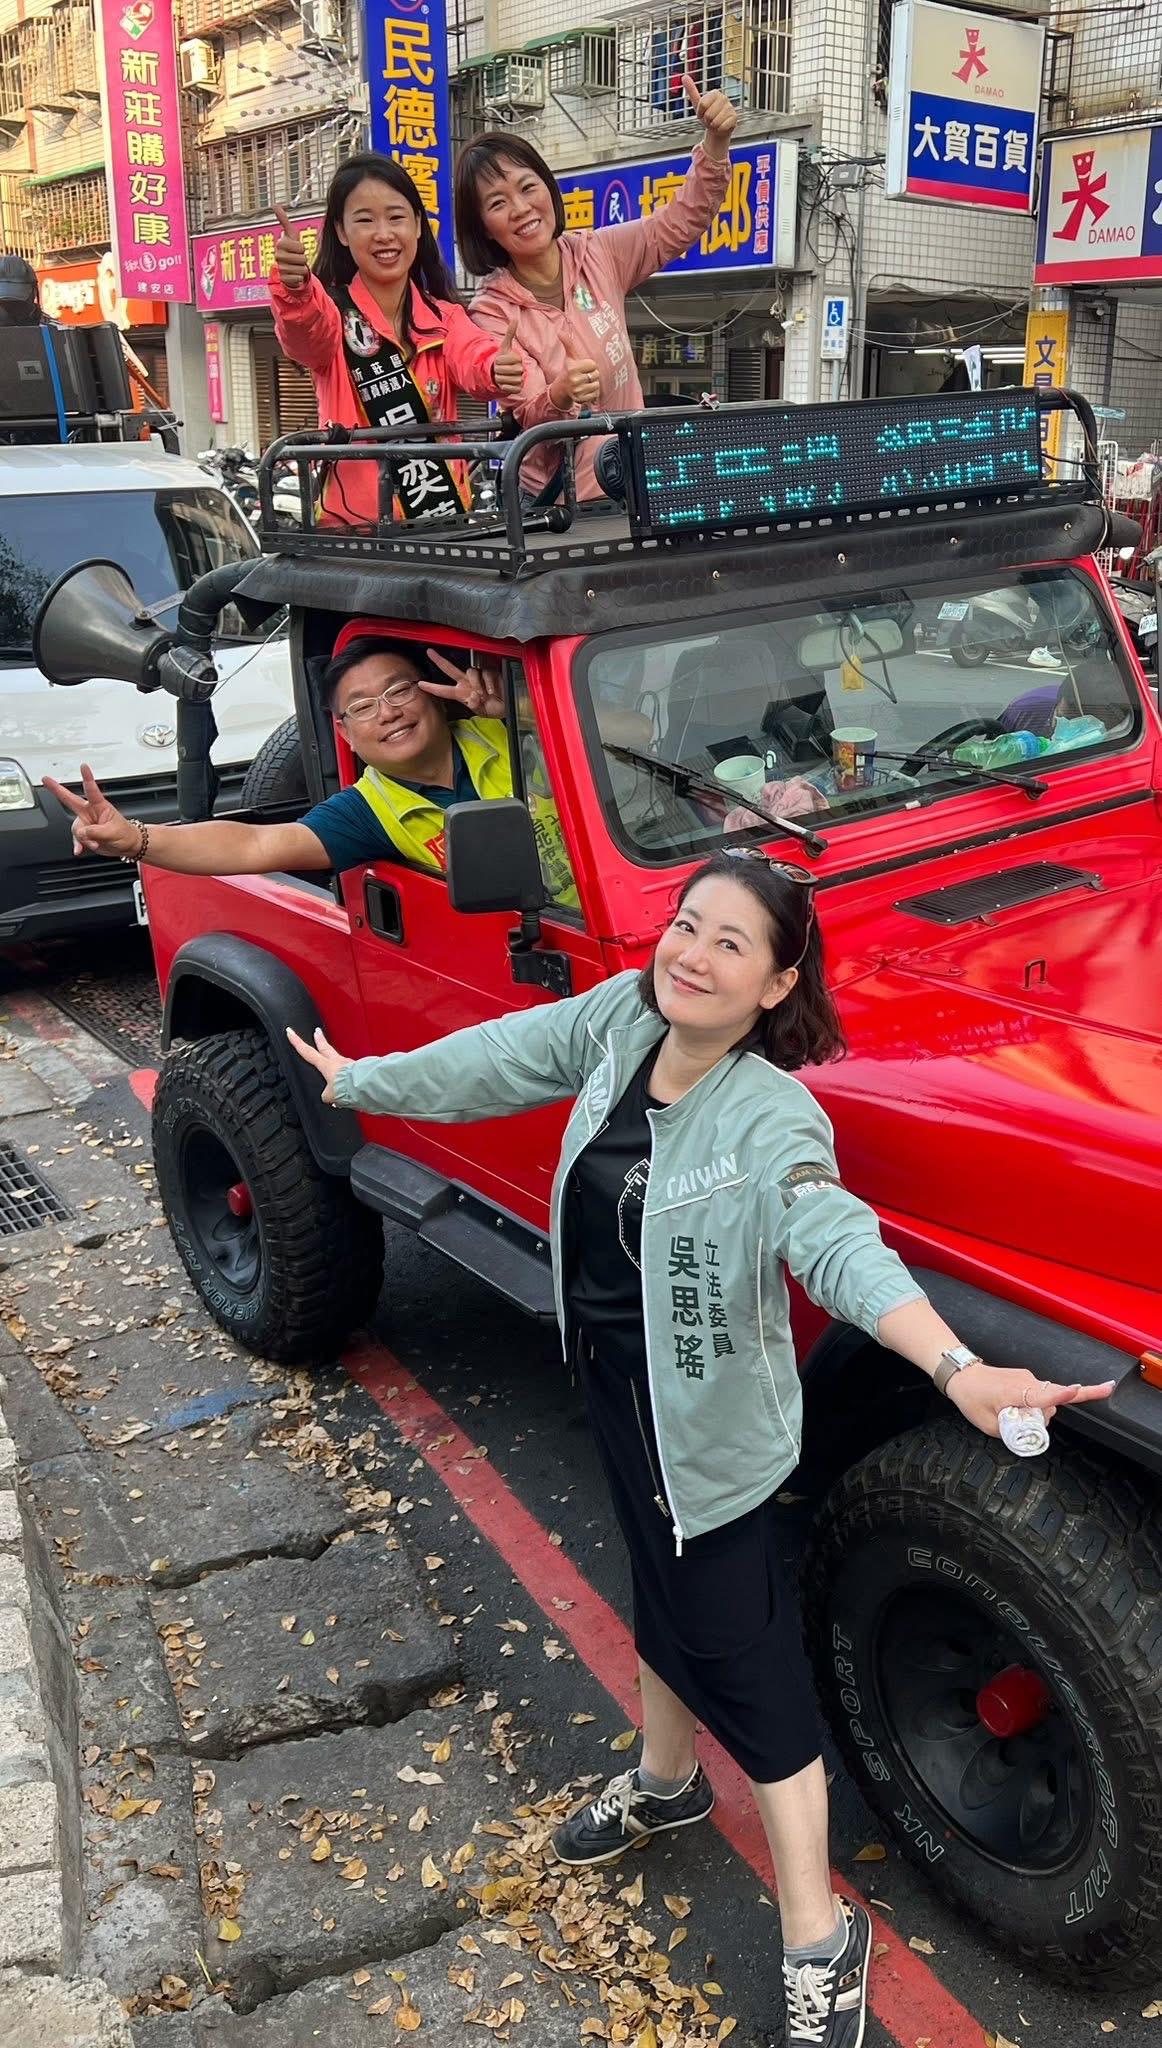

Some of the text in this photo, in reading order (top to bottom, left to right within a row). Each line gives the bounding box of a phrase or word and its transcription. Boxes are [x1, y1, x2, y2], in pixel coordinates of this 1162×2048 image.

[974, 84, 1005, 98] DAMAO
[119, 48, 171, 246] 新莊購好康
[912, 115, 1029, 174] 大貿百貨
[220, 226, 319, 284] 新莊購康
[753, 154, 771, 255] 平價供應
[1087, 225, 1136, 245] DAMAO
[668, 1235, 706, 1381] 吳思瑤
[704, 1239, 737, 1359] 立法委員
[832, 1623, 945, 1863] NK SPORT
